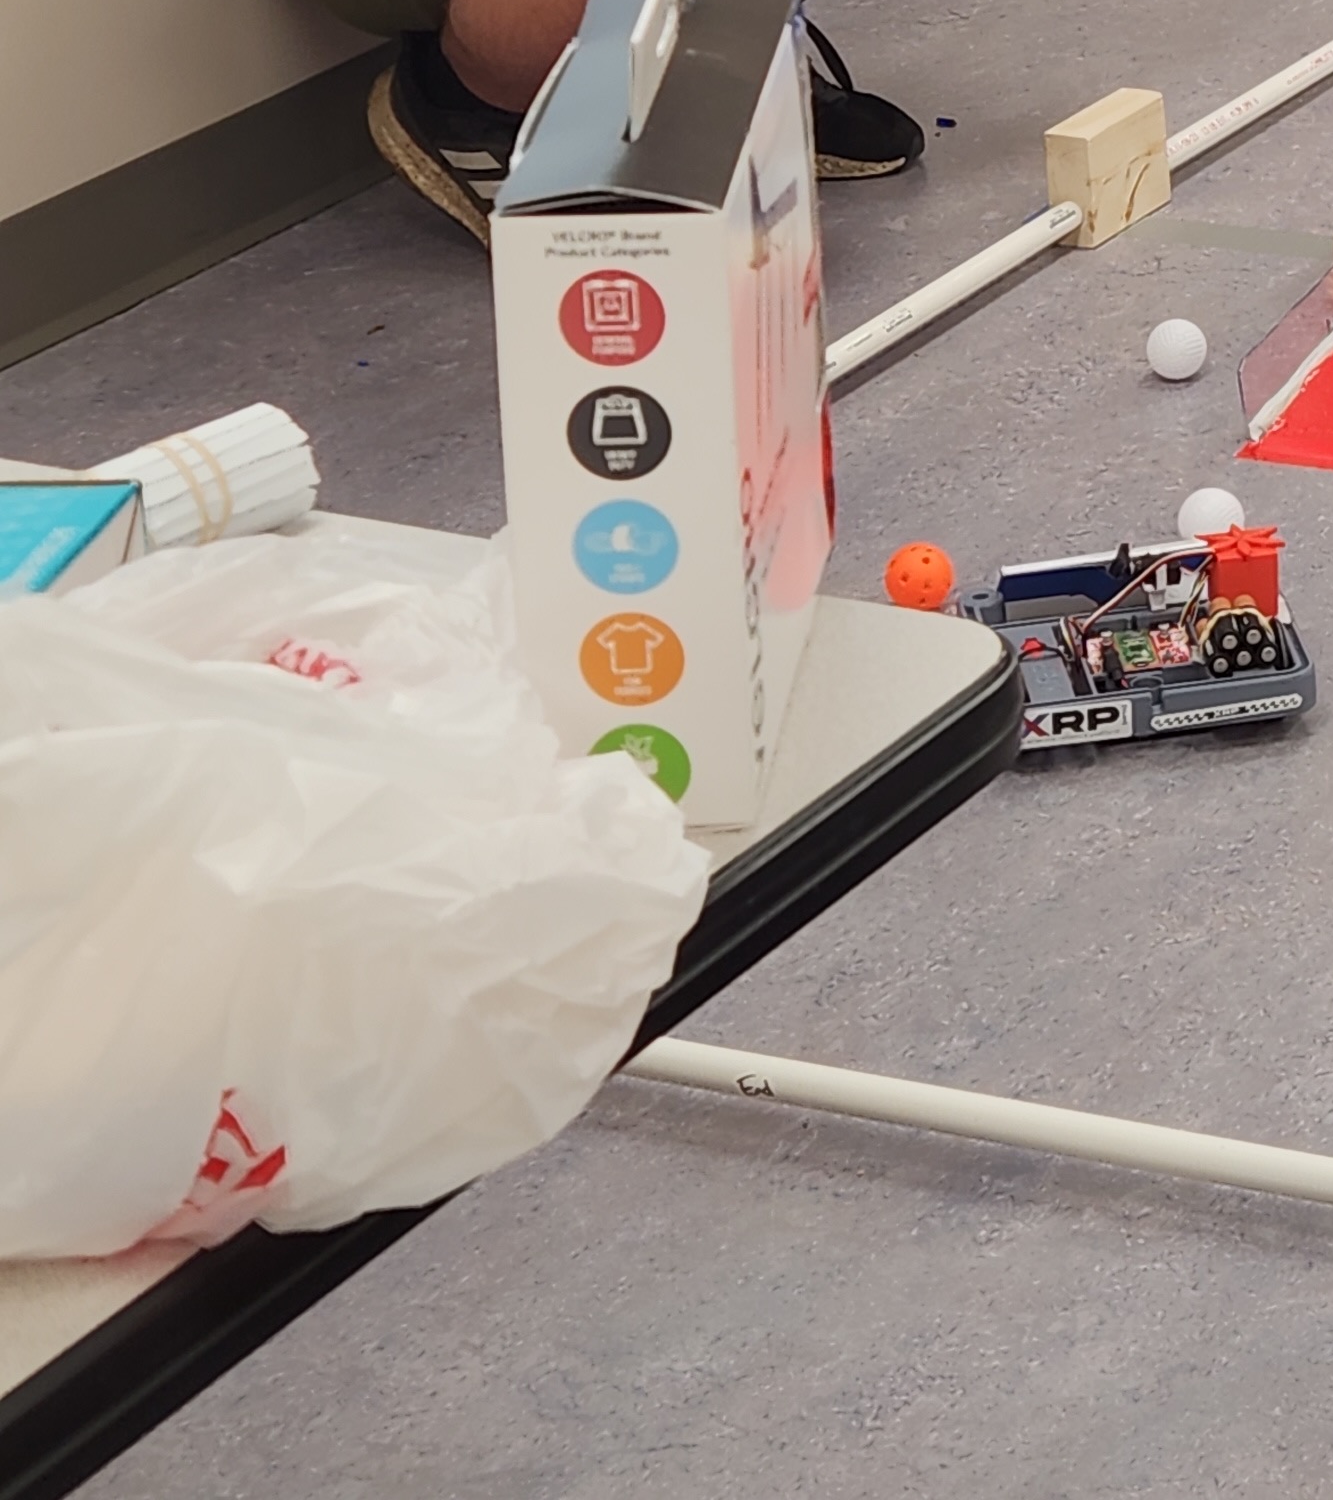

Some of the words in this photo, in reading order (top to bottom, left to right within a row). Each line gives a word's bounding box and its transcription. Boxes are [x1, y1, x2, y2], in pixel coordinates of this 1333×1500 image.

[543, 247, 597, 259] Product
[601, 246, 671, 260] Categories
[1022, 706, 1120, 738] XRP
